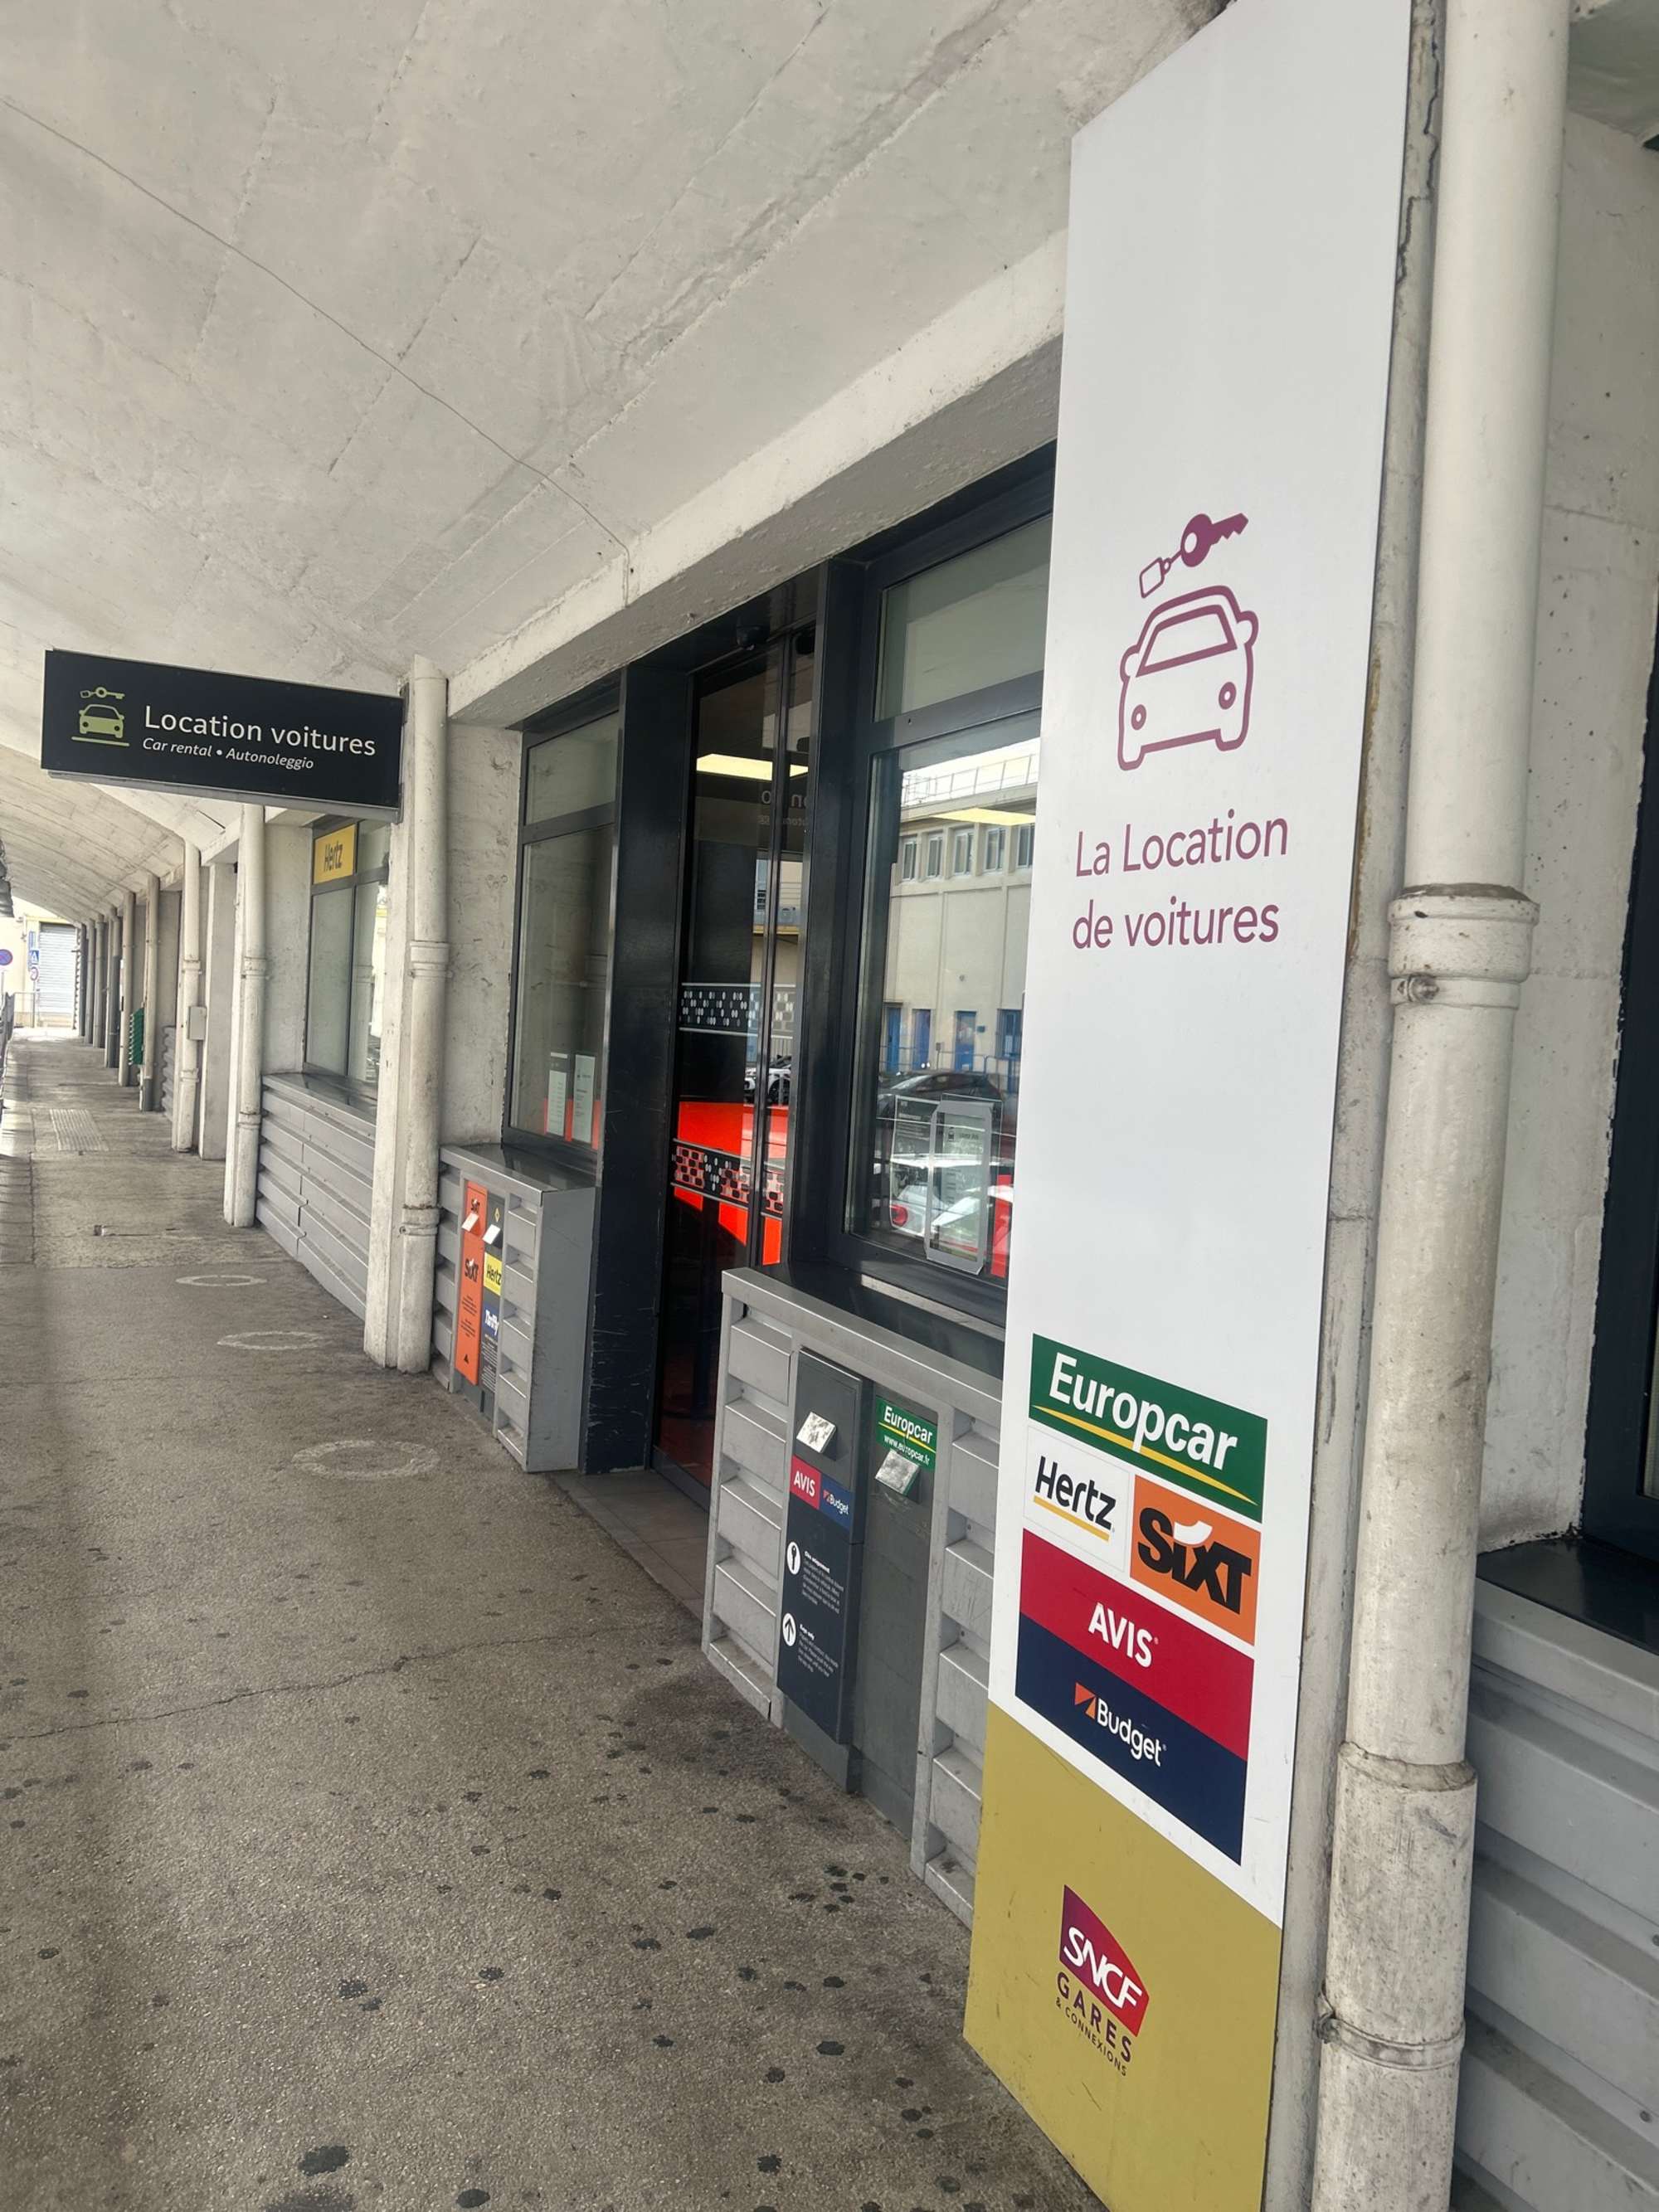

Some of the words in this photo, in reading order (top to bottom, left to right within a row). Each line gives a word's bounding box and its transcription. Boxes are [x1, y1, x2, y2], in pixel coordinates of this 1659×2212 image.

[143, 737, 168, 751] Car
[170, 741, 212, 757] rental
[226, 747, 314, 770] Autonoleggio
[145, 705, 262, 741] Location
[270, 726, 376, 756] voitures
[1076, 830, 1111, 877] La
[1122, 808, 1288, 873] Location
[1073, 899, 1113, 949] de
[1125, 895, 1280, 947] voitures
[486, 1263, 502, 1286] Hertz
[883, 1405, 933, 1444] Europcar
[1049, 1351, 1238, 1471] Europcar
[794, 1471, 815, 1497] AVIS
[829, 1493, 849, 1515] Budget
[1035, 1456, 1117, 1530] Hertz
[1088, 1602, 1152, 1668] AVIS
[1097, 1697, 1161, 1767] Budget
[1063, 1927, 1142, 2009] SNCF
[1056, 1996, 1062, 2009] &
[1065, 2005, 1126, 2077] CONNEXIONS
[1057, 1971, 1131, 2064] GARES
